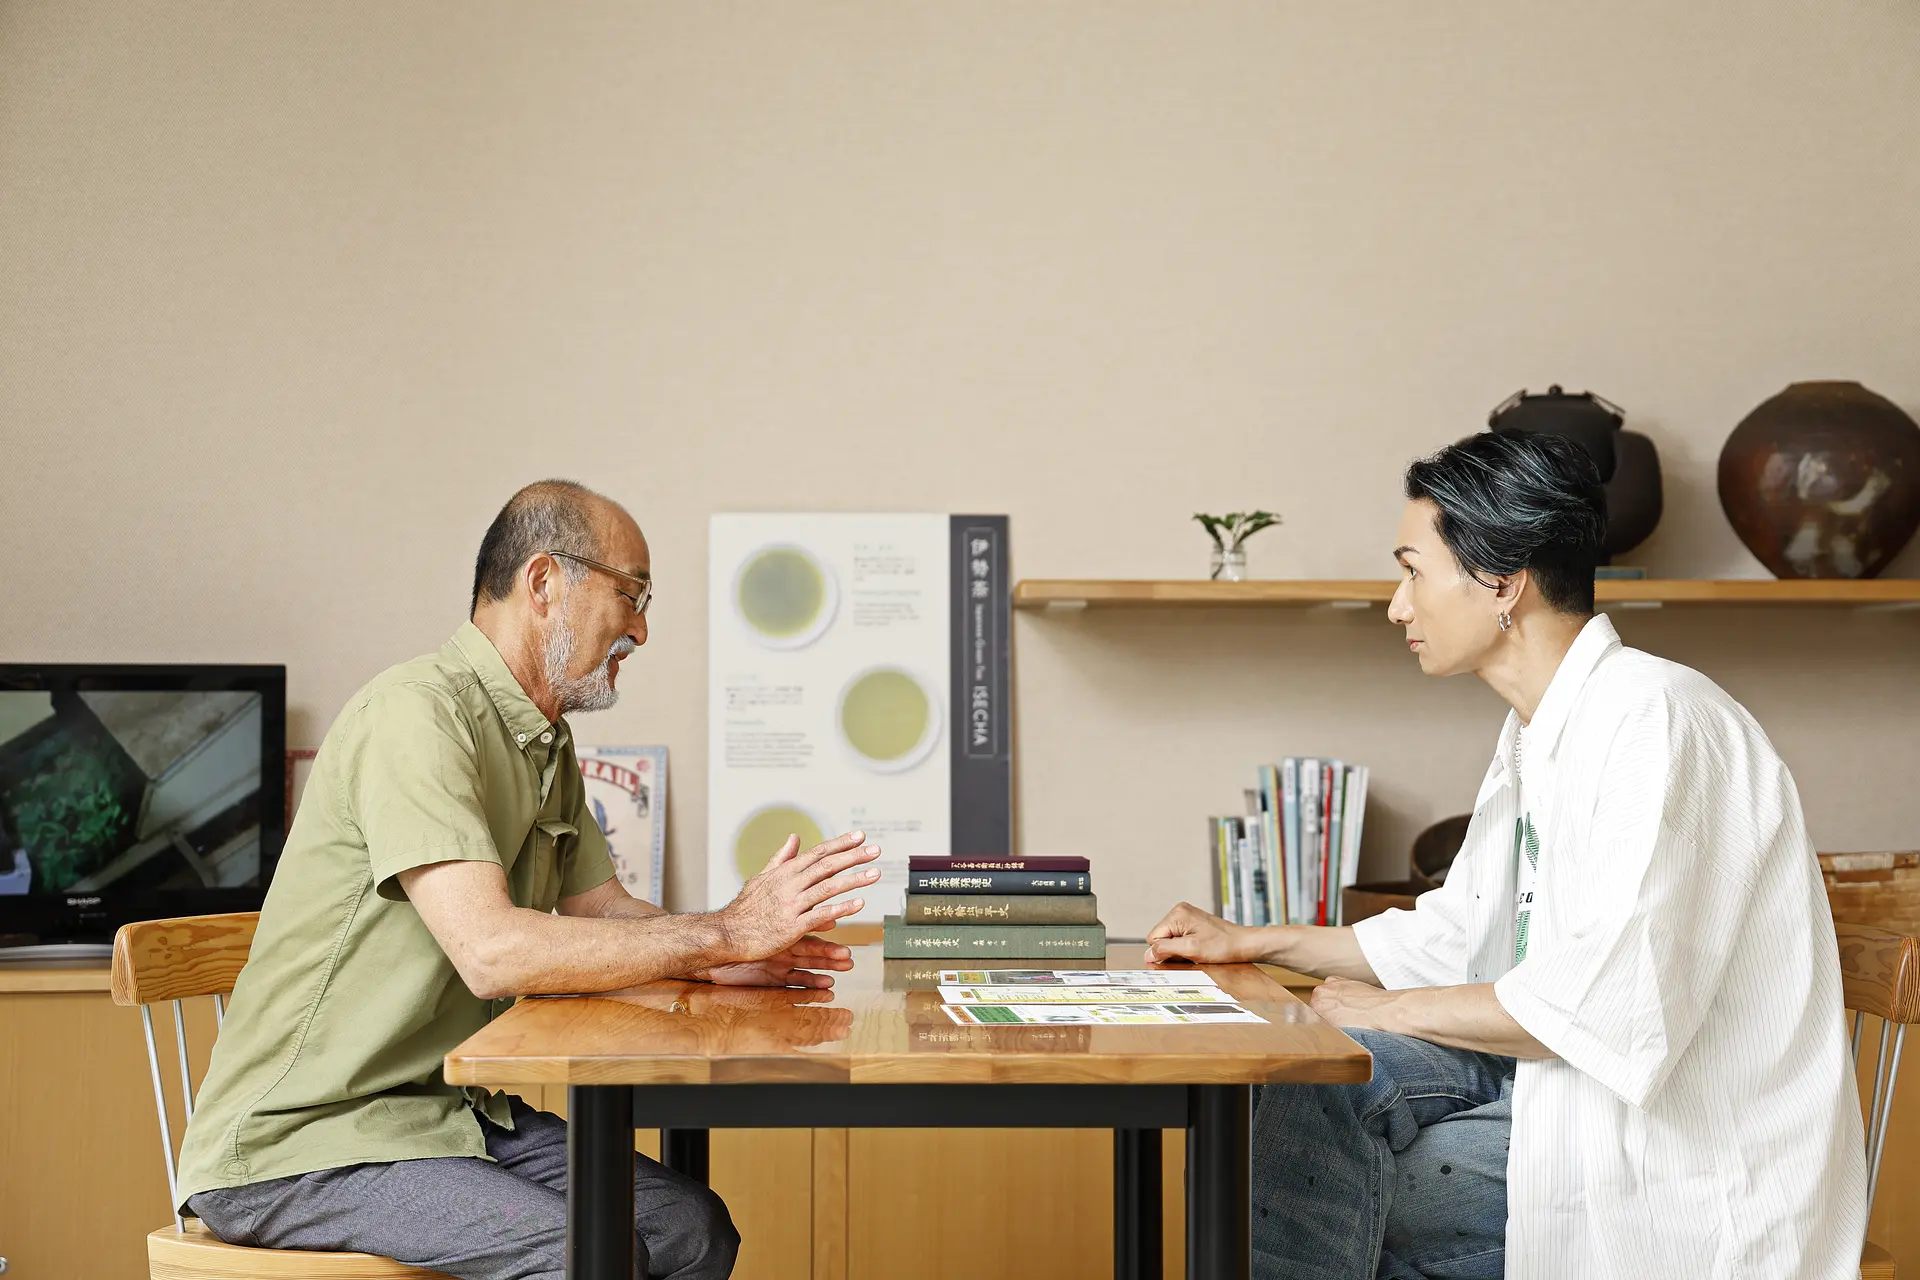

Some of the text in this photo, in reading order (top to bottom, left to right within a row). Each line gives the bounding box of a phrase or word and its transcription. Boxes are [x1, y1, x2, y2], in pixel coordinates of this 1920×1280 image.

[972, 685, 989, 747] ISECHA
[919, 877, 992, 888] 日本茶業発達史
[66, 897, 102, 906] SHARP
[923, 903, 1009, 919] 日本茶輸出百年史
